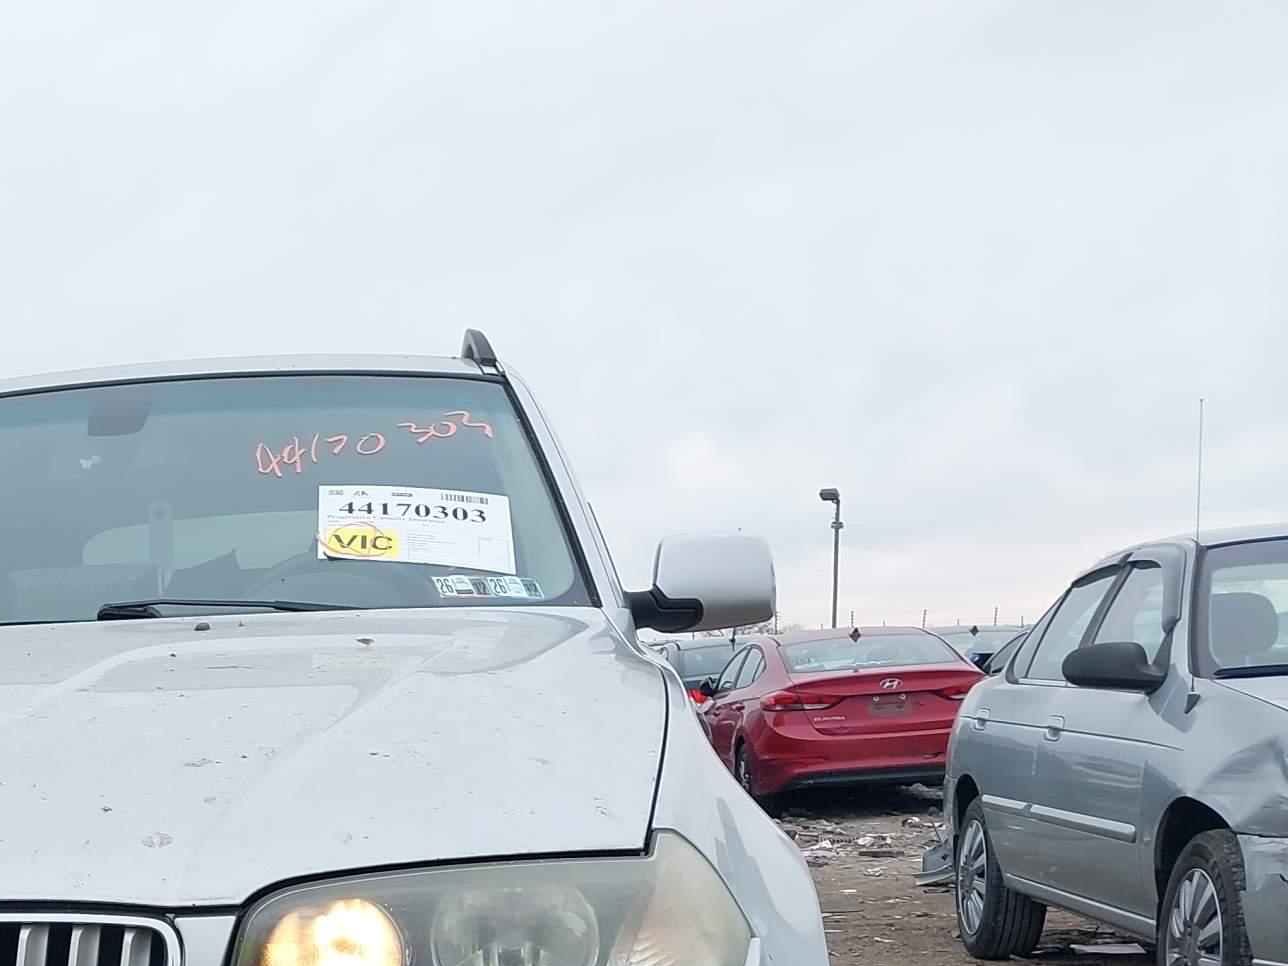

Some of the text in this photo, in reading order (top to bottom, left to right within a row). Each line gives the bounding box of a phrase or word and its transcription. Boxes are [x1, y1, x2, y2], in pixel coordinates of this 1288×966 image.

[339, 501, 487, 523] 44170303
[332, 534, 393, 551] VIC
[436, 578, 454, 594] 26
[489, 578, 508, 594] 26
